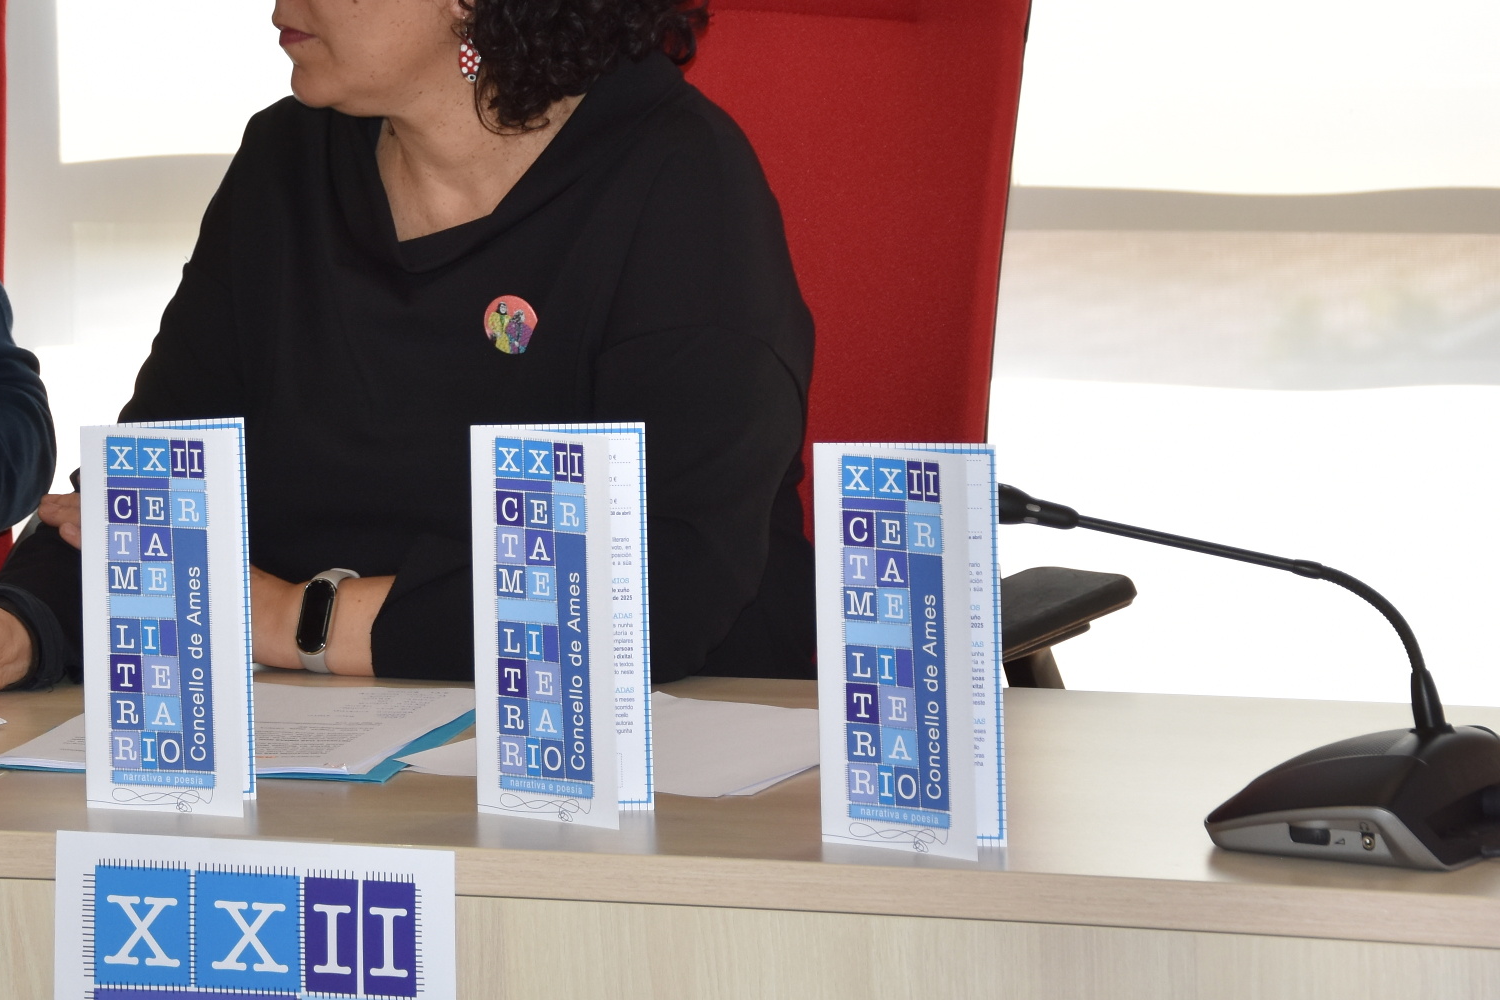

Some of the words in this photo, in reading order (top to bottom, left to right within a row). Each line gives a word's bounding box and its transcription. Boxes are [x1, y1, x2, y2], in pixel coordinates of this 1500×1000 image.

[109, 447, 202, 473] XXII
[499, 448, 583, 476] XXII
[845, 466, 938, 497] XXII
[113, 495, 200, 521] CER
[502, 497, 579, 527] CER
[114, 532, 168, 556] TA
[849, 517, 934, 547] CER
[502, 533, 550, 562] TA
[111, 566, 168, 592] ME
[850, 554, 904, 583] TA
[186, 566, 201, 625] Ames
[499, 569, 550, 596] ME
[567, 572, 580, 631] Ames
[847, 591, 904, 618] ME
[116, 624, 156, 649] LI
[923, 595, 936, 657] Ames
[187, 634, 203, 659] de
[504, 629, 541, 655] LI
[568, 641, 583, 667] de
[117, 663, 171, 689] TE
[853, 652, 894, 680] LI
[923, 667, 939, 692] de
[504, 668, 553, 695] TE
[116, 701, 175, 725] RA
[189, 668, 206, 762] Concello
[504, 707, 558, 734] RA
[853, 694, 907, 722] TE
[569, 676, 585, 770] Concello
[114, 737, 180, 763] RIO
[502, 743, 562, 770] RIO
[854, 732, 912, 761] RA
[923, 703, 942, 800] Concello
[124, 773, 162, 782] narrativa
[510, 779, 546, 790] narrativa
[852, 769, 917, 799] RIO
[104, 895, 409, 978] XXII
